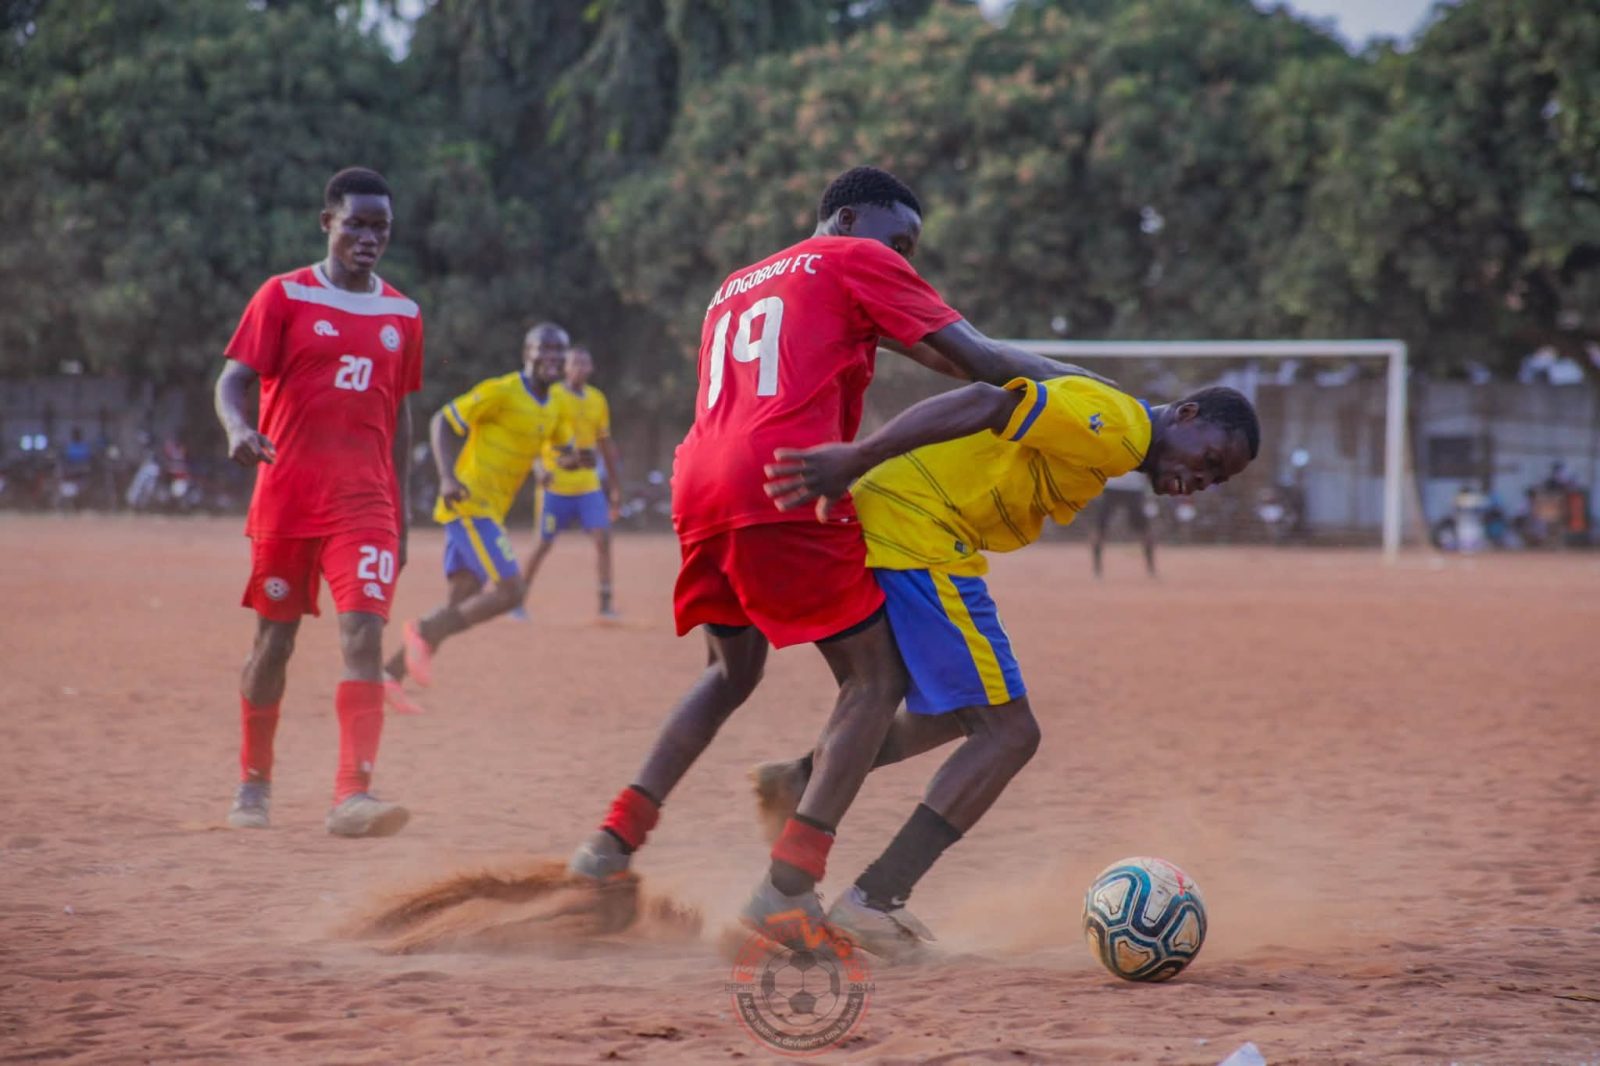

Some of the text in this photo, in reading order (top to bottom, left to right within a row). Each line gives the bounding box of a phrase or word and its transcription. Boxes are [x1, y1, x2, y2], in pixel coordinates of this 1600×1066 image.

[791, 253, 822, 275] FC
[707, 296, 784, 409] 19
[334, 354, 374, 392] 20
[357, 544, 394, 585] 20
